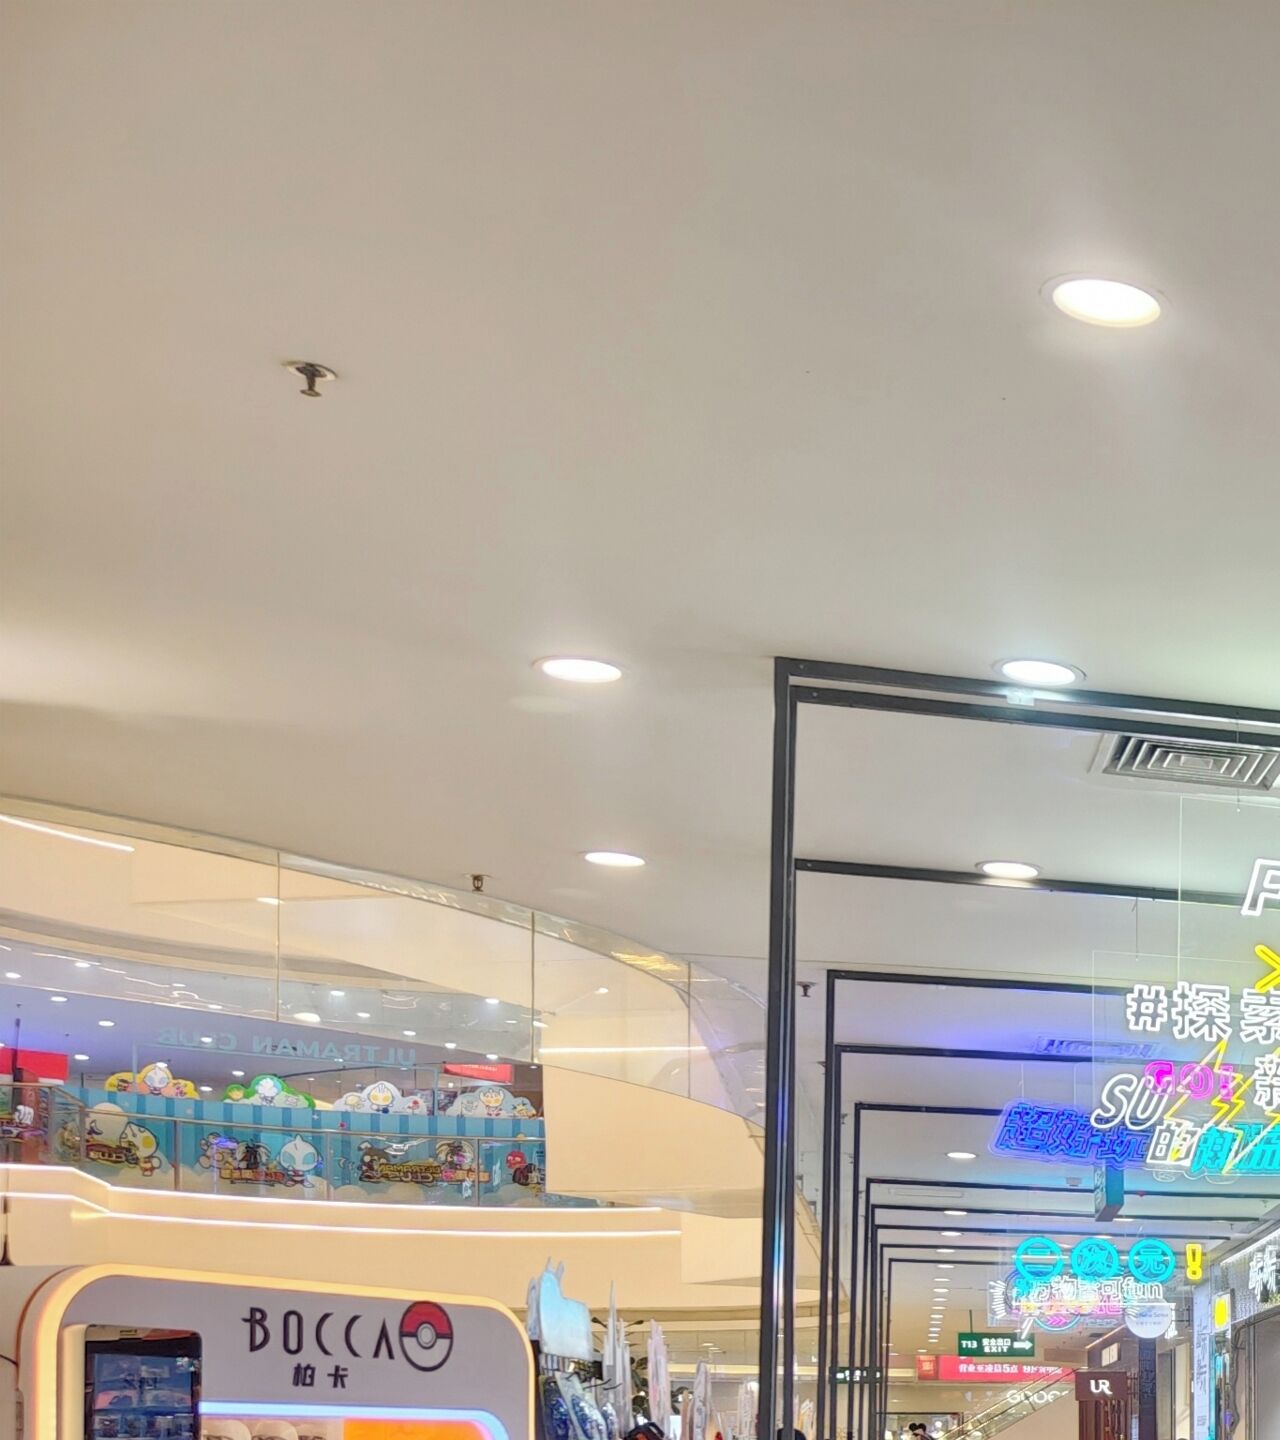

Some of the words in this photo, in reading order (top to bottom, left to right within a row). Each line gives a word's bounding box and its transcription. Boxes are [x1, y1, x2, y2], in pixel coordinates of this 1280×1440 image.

[961, 1340, 977, 1348] T13
[982, 1337, 1011, 1346] 安全出口
[984, 1345, 1009, 1353] EXIT
[292, 1363, 349, 1389] 柏卡
[1089, 1379, 1113, 1395] UR
